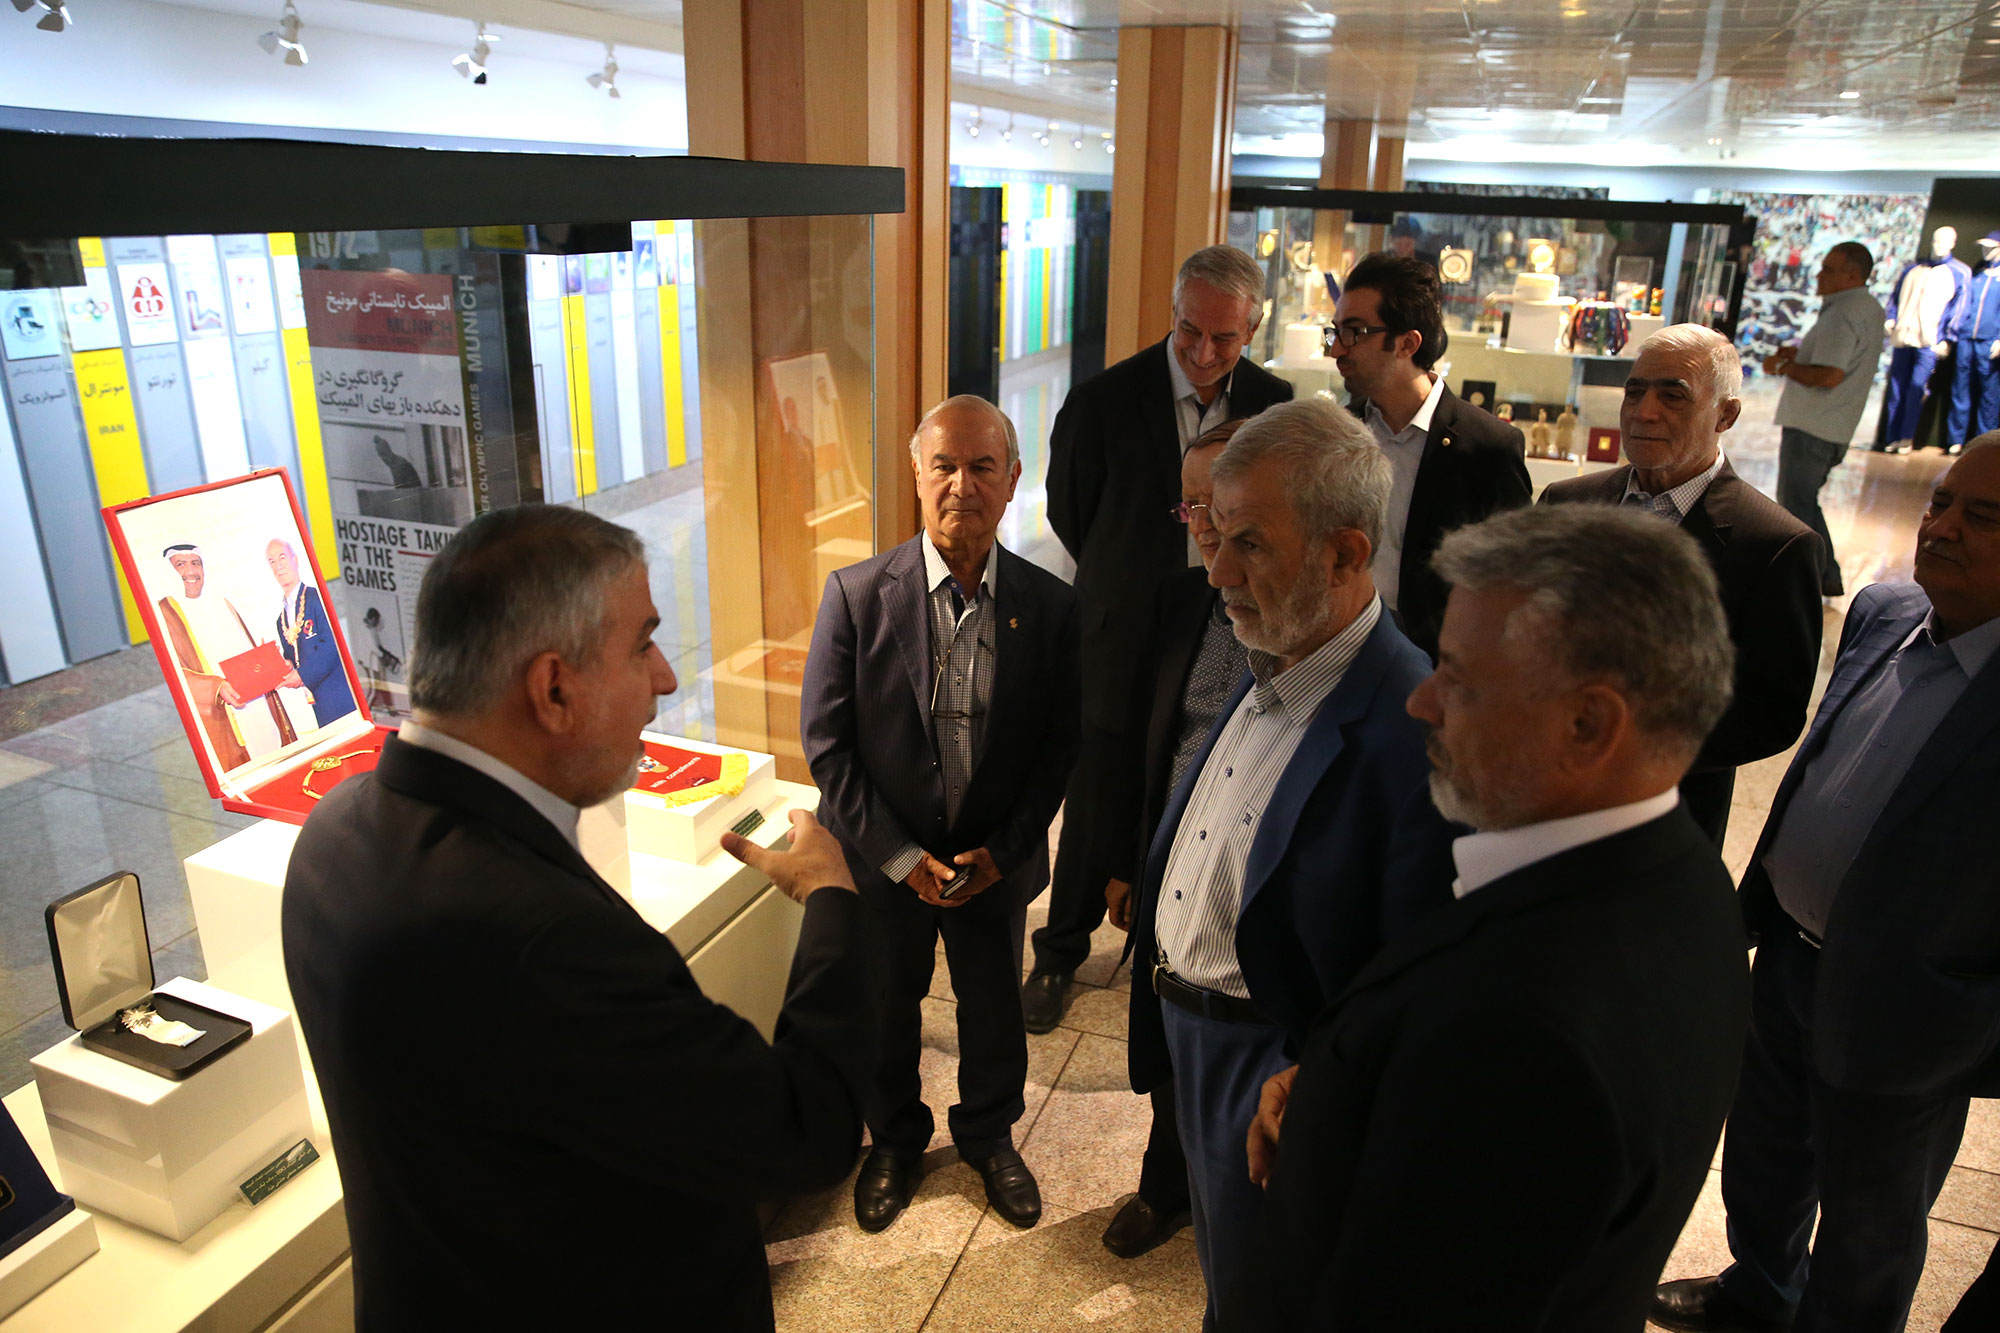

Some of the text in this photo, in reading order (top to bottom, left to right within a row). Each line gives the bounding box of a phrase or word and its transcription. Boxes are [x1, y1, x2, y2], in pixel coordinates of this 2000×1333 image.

[325, 290, 451, 317] المپیک تابستانی مونیخ
[458, 274, 484, 372] MUNICH
[319, 391, 364, 414] المپیک
[415, 399, 461, 417] دهکده
[469, 382, 483, 431] GAMES
[98, 424, 125, 436] IRAN
[474, 433, 490, 492] OLYMPIC
[336, 518, 409, 549] HOSTAGE
[342, 543, 395, 569] AT THE
[344, 565, 397, 592] GAMES
